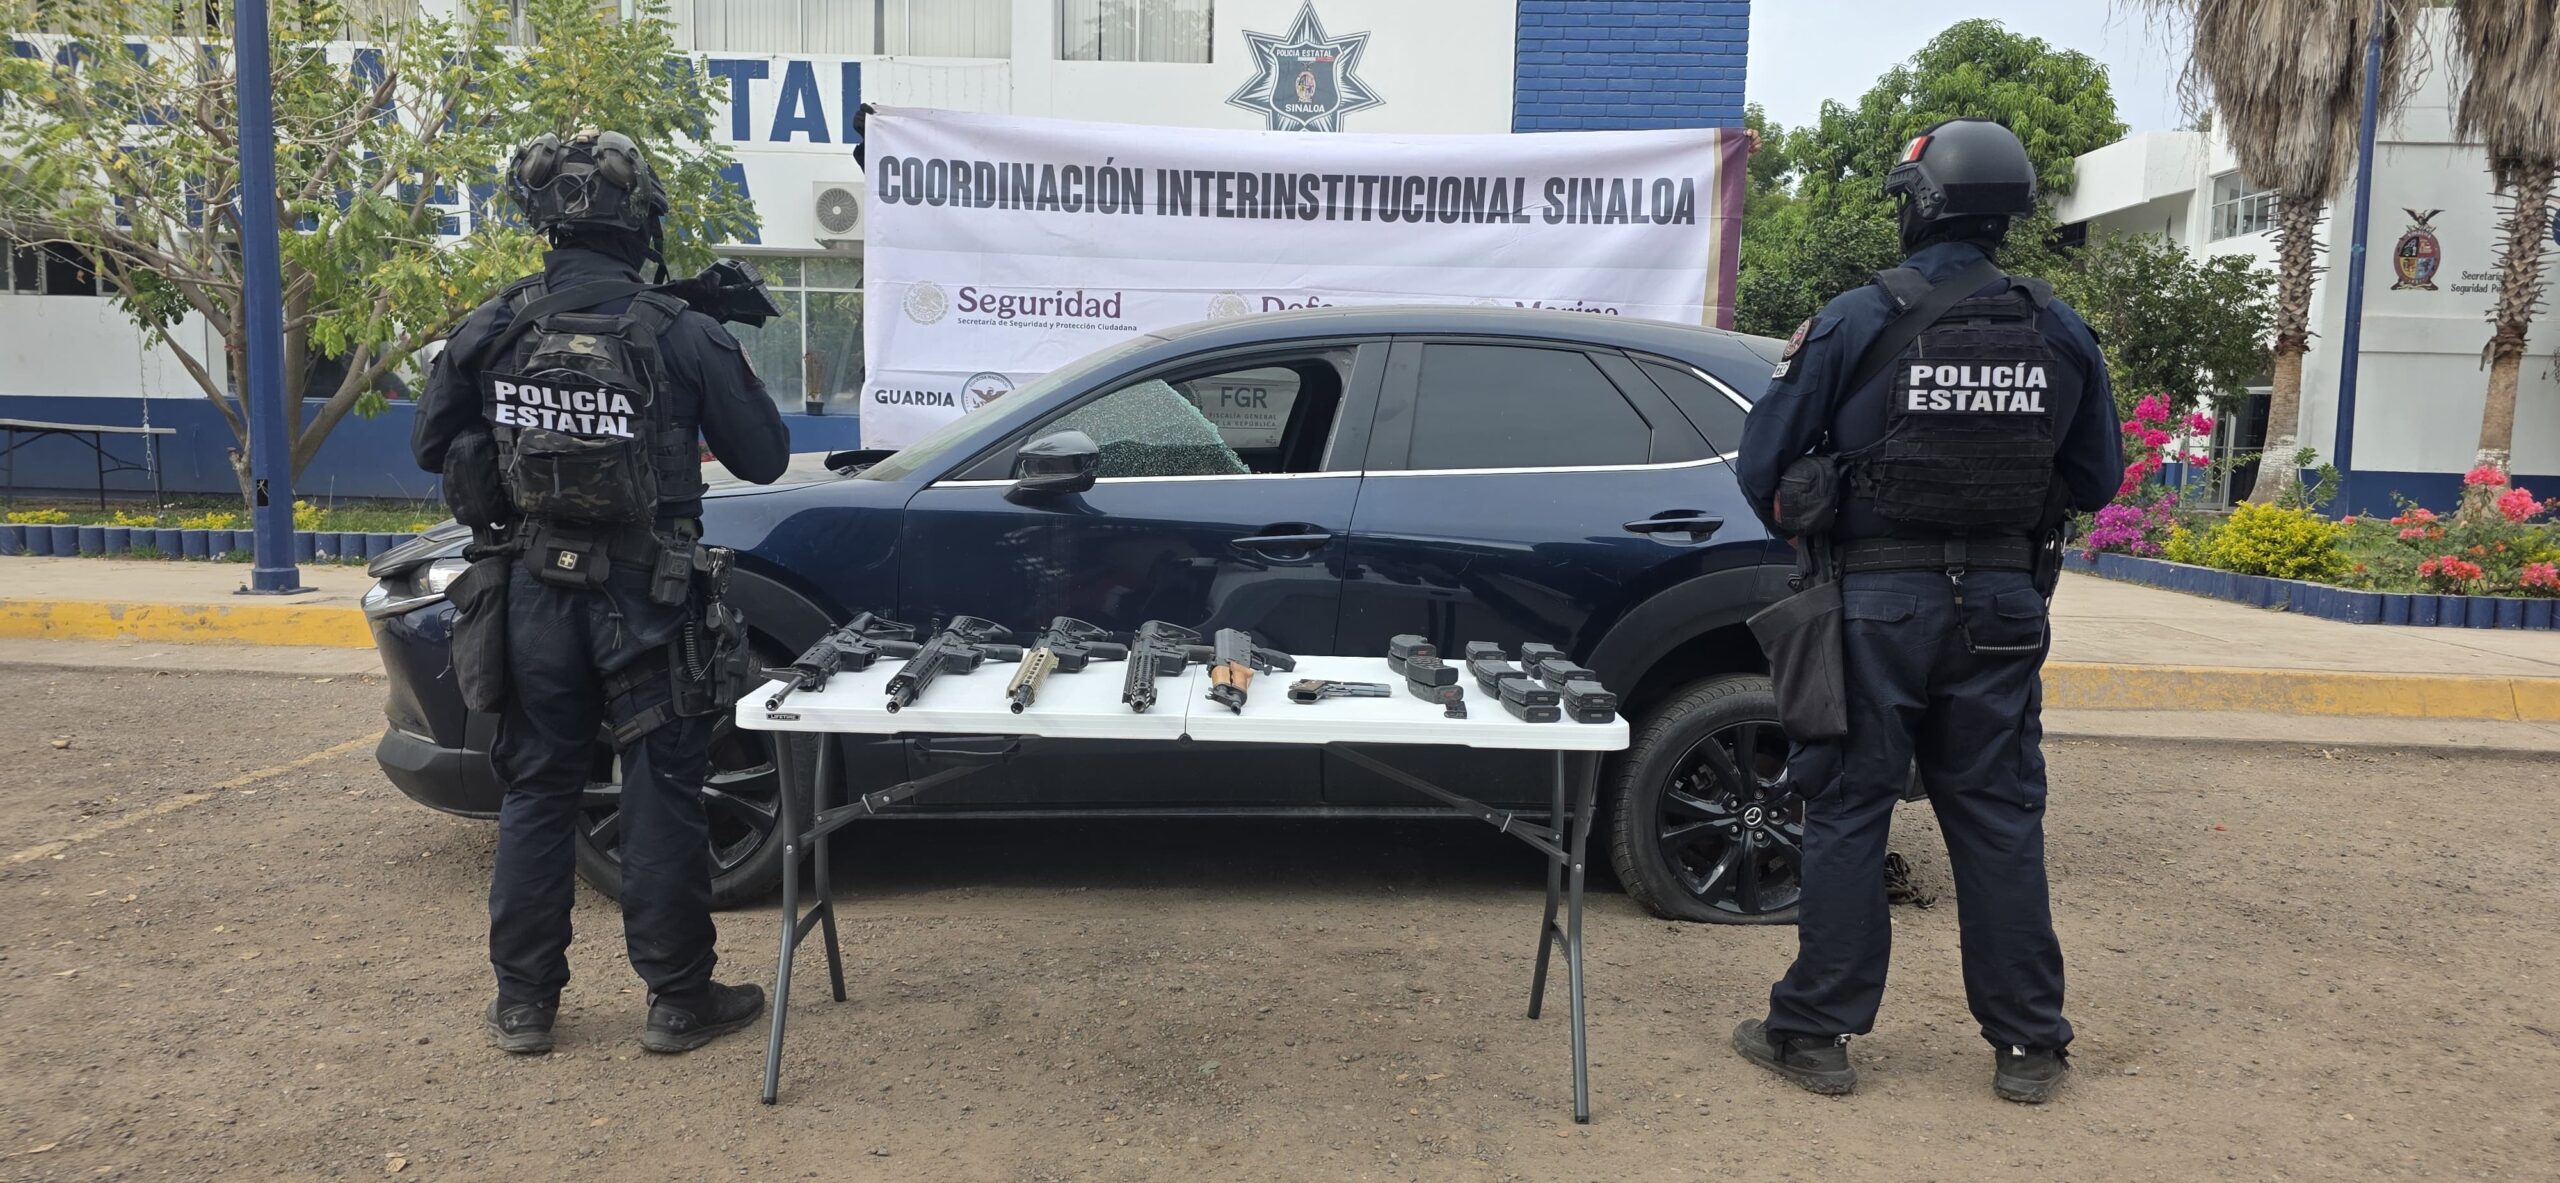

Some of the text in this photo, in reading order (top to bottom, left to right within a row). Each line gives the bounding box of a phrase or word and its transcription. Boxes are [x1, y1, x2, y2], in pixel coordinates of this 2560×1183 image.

[1276, 48, 1333, 58] POLICIA ESTATAL
[1285, 103, 1325, 113] SINALOA
[878, 155, 1695, 225] COORDINACIÓN INTERINSTITUCIONAL SINALOA
[2450, 283, 2488, 296] Seguridad
[957, 286, 1121, 319] Seguridad
[957, 317, 997, 326] Secretaría
[1009, 320, 1048, 328] Seguridad
[1049, 322, 1055, 330] y
[1055, 322, 1096, 330] Protección
[1097, 323, 1137, 332] Ciudadana
[1909, 361, 2048, 389] POLICÍA
[494, 379, 635, 415] POLICÍA
[874, 389, 955, 407] GUARDIA
[1220, 386, 1268, 409] FGR
[1908, 389, 2046, 413] ESTATAL
[494, 403, 635, 438] ESTATAL
